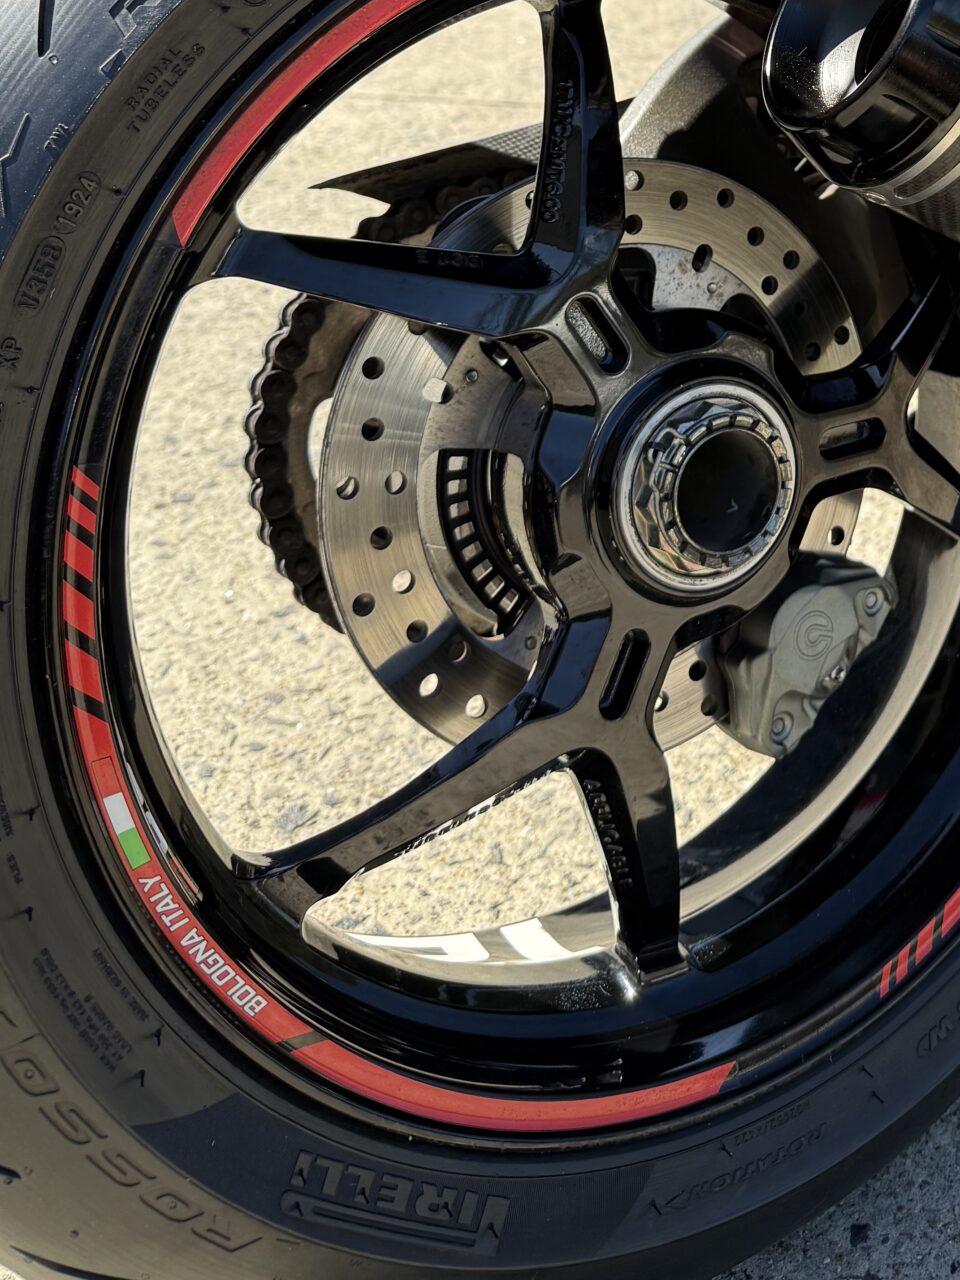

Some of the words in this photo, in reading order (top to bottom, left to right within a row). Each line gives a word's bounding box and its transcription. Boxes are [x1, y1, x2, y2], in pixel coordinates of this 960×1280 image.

[124, 47, 182, 111] RADIAL
[126, 42, 206, 133] TUBELESS
[57, 175, 100, 232] 1924
[138, 875, 190, 932] ITALY
[180, 927, 269, 1017] BOLOGNA
[0, 1042, 263, 1253] ROSSO
[685, 1120, 828, 1202] ROTATION
[280, 1150, 512, 1258] PIRELLI
